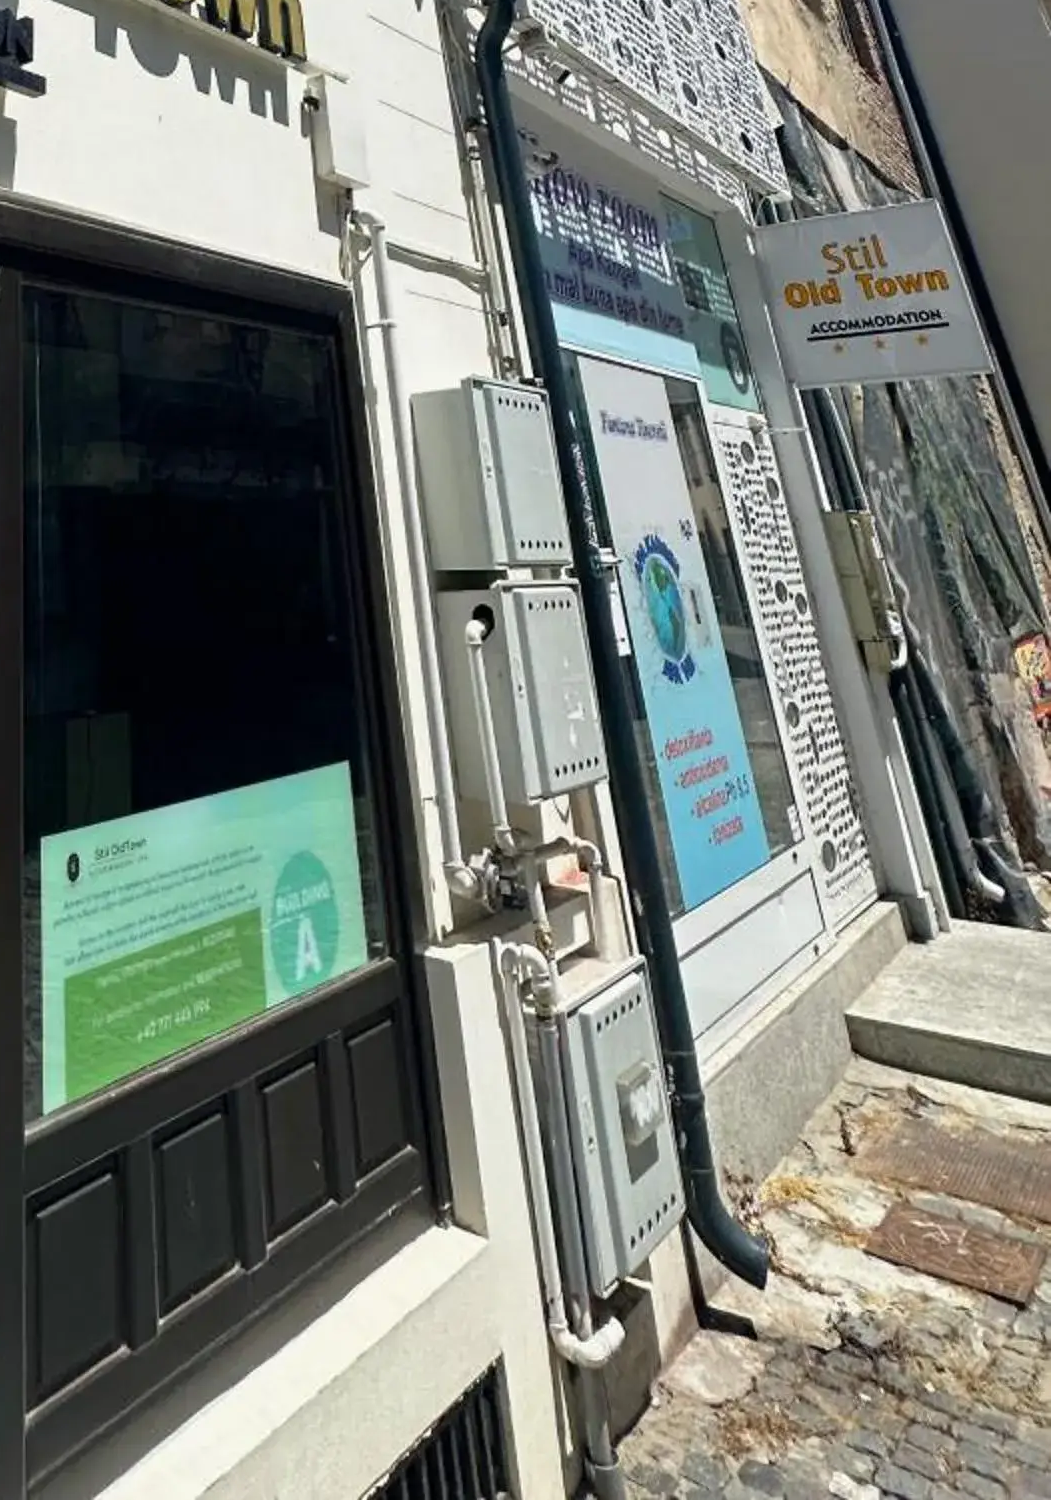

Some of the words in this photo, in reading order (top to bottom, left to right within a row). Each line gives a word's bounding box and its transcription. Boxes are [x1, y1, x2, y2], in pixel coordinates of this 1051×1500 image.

[821, 234, 888, 276] Stil
[783, 275, 842, 310] Old
[856, 266, 949, 301] Town
[809, 308, 943, 336] ACCOMMODATION
[295, 915, 323, 981] A
